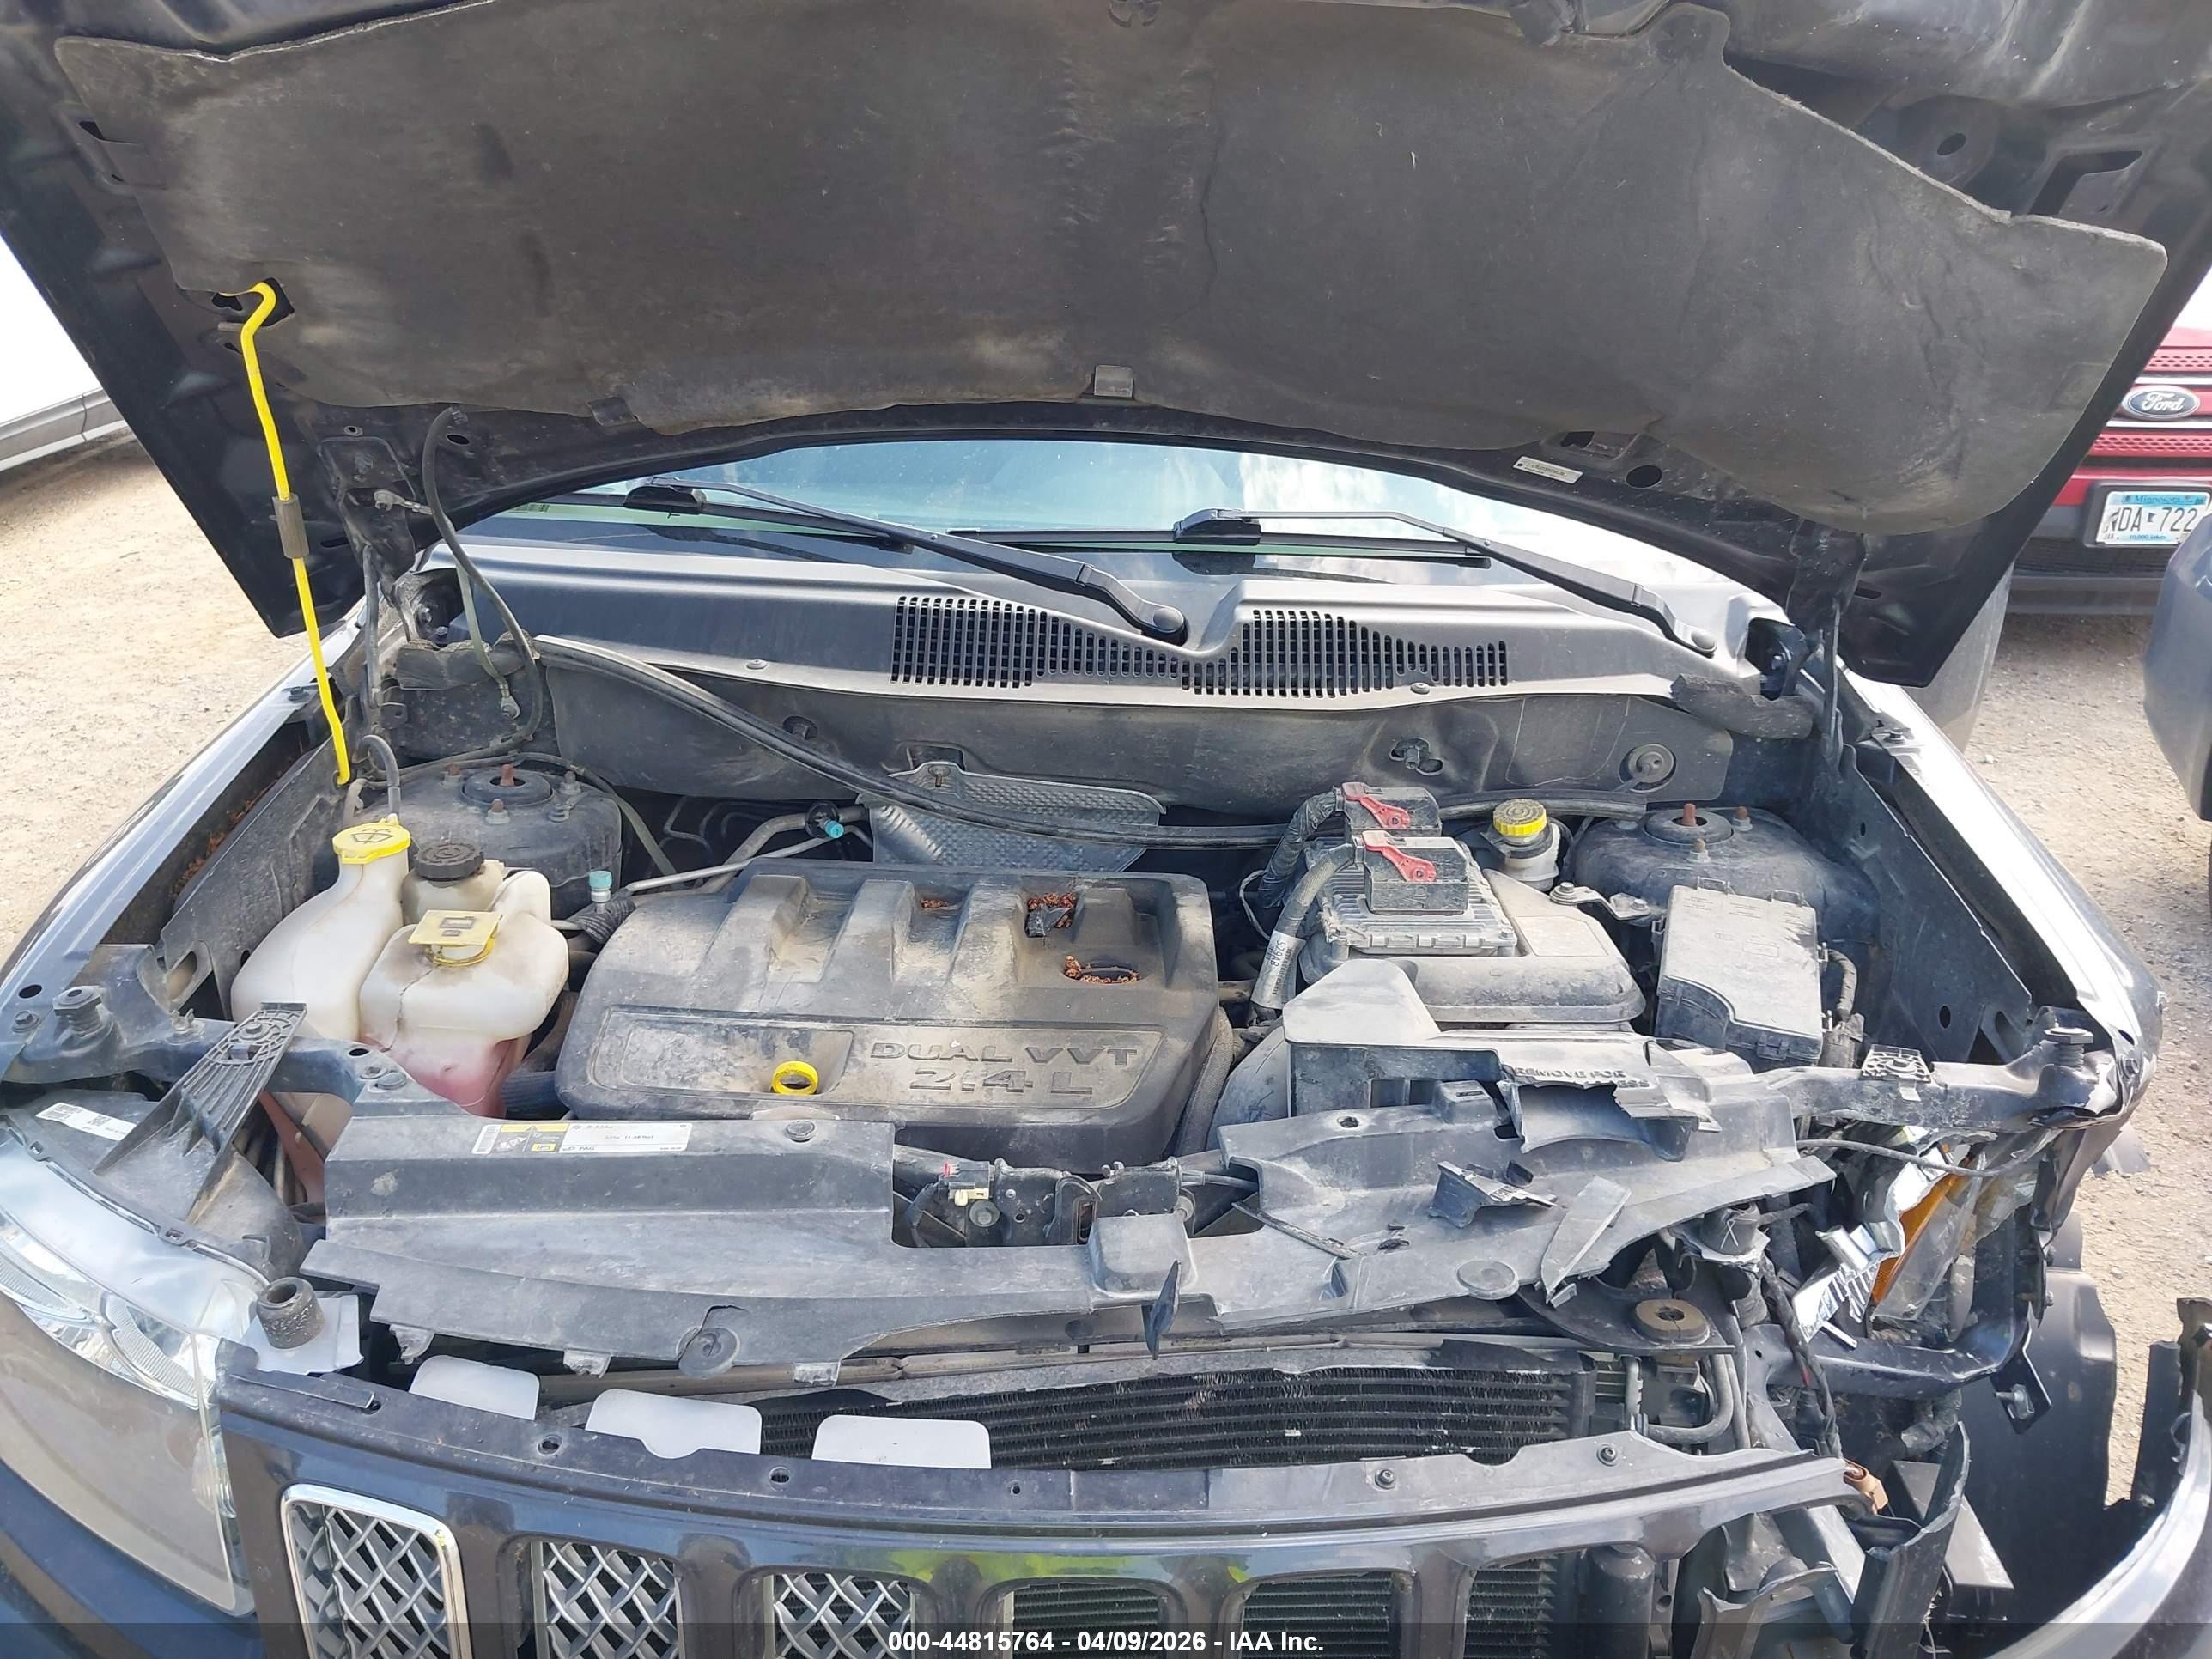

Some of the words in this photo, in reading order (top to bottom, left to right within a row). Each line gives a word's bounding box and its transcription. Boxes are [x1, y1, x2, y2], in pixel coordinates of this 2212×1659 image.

[2142, 392, 2185, 411] Ford
[870, 1041, 1013, 1063] DUAL
[1024, 1046, 1139, 1066] VVT
[1514, 1066, 1587, 1079] REMOVE
[1589, 1070, 1626, 1079] FOR
